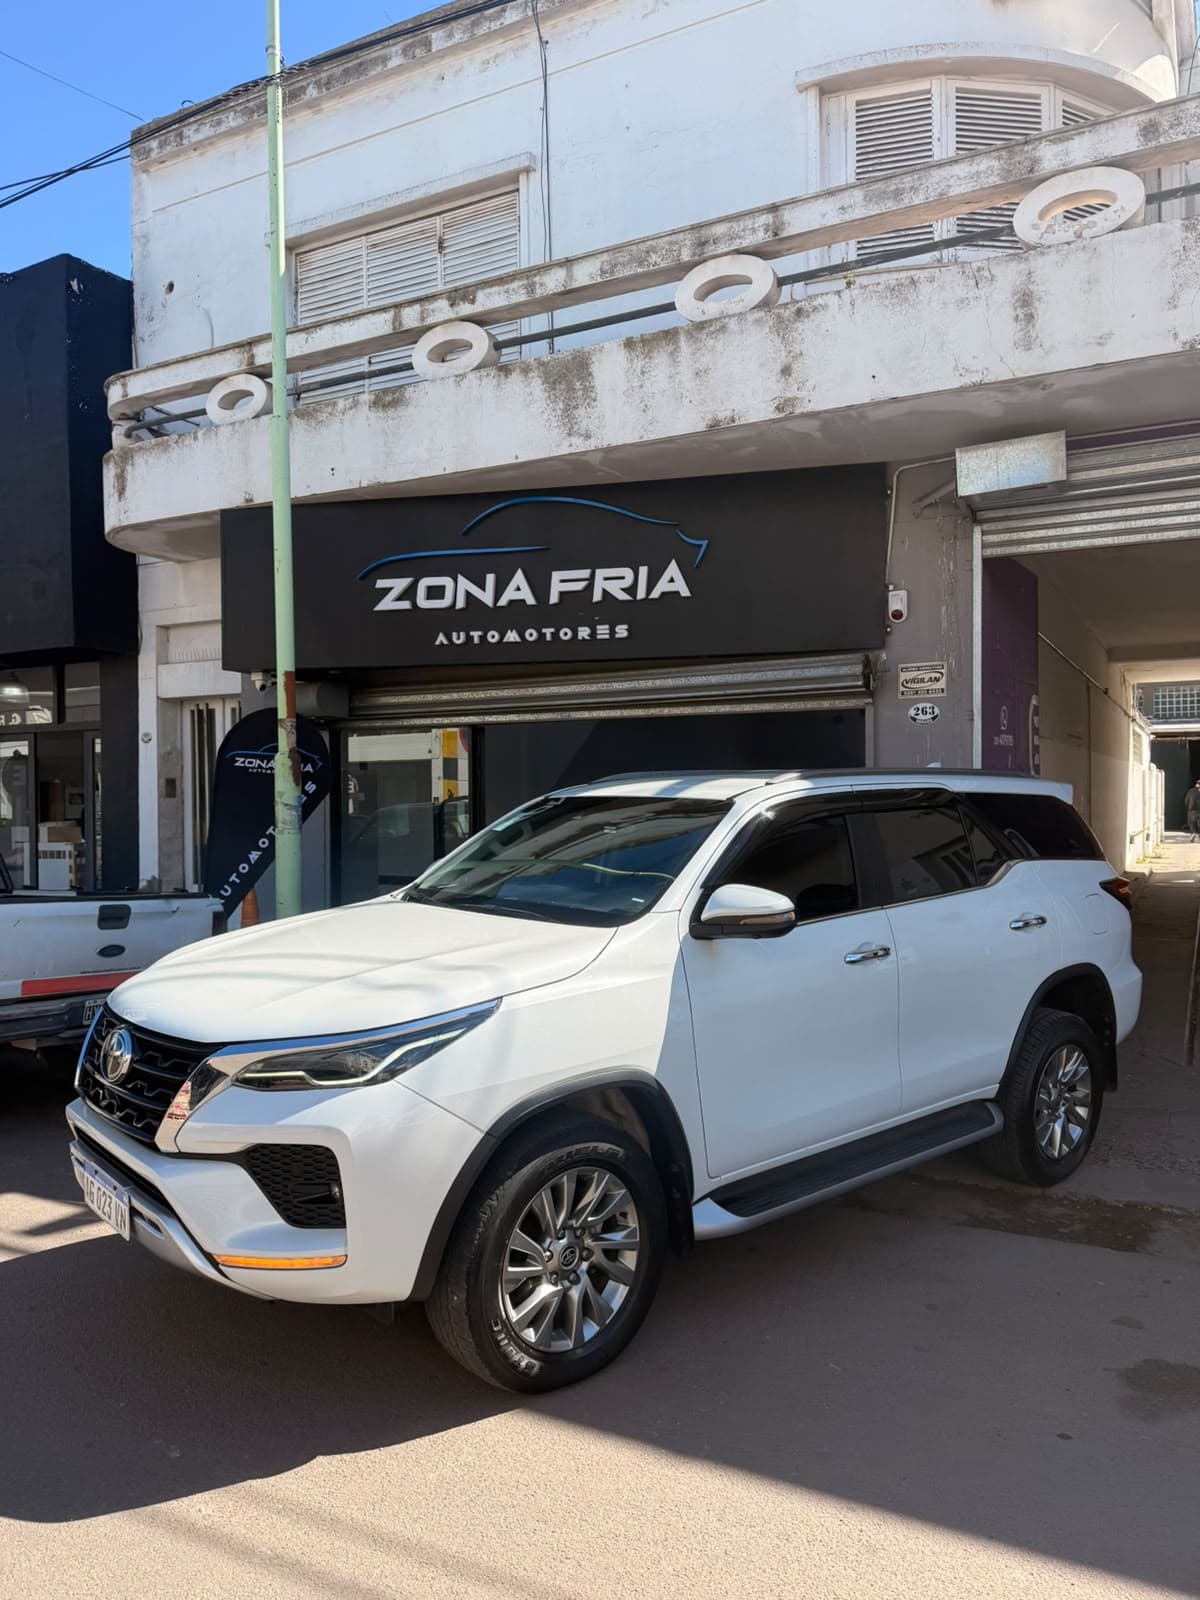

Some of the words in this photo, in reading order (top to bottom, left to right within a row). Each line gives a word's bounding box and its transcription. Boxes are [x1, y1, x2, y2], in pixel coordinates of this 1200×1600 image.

[373, 568, 537, 611] ZONA
[549, 558, 692, 605] FRIA
[434, 624, 630, 646] AUTOMOTORES
[904, 675, 941, 685] VIGILAN
[913, 705, 936, 717] 263
[96, 1186, 113, 1220] 023
